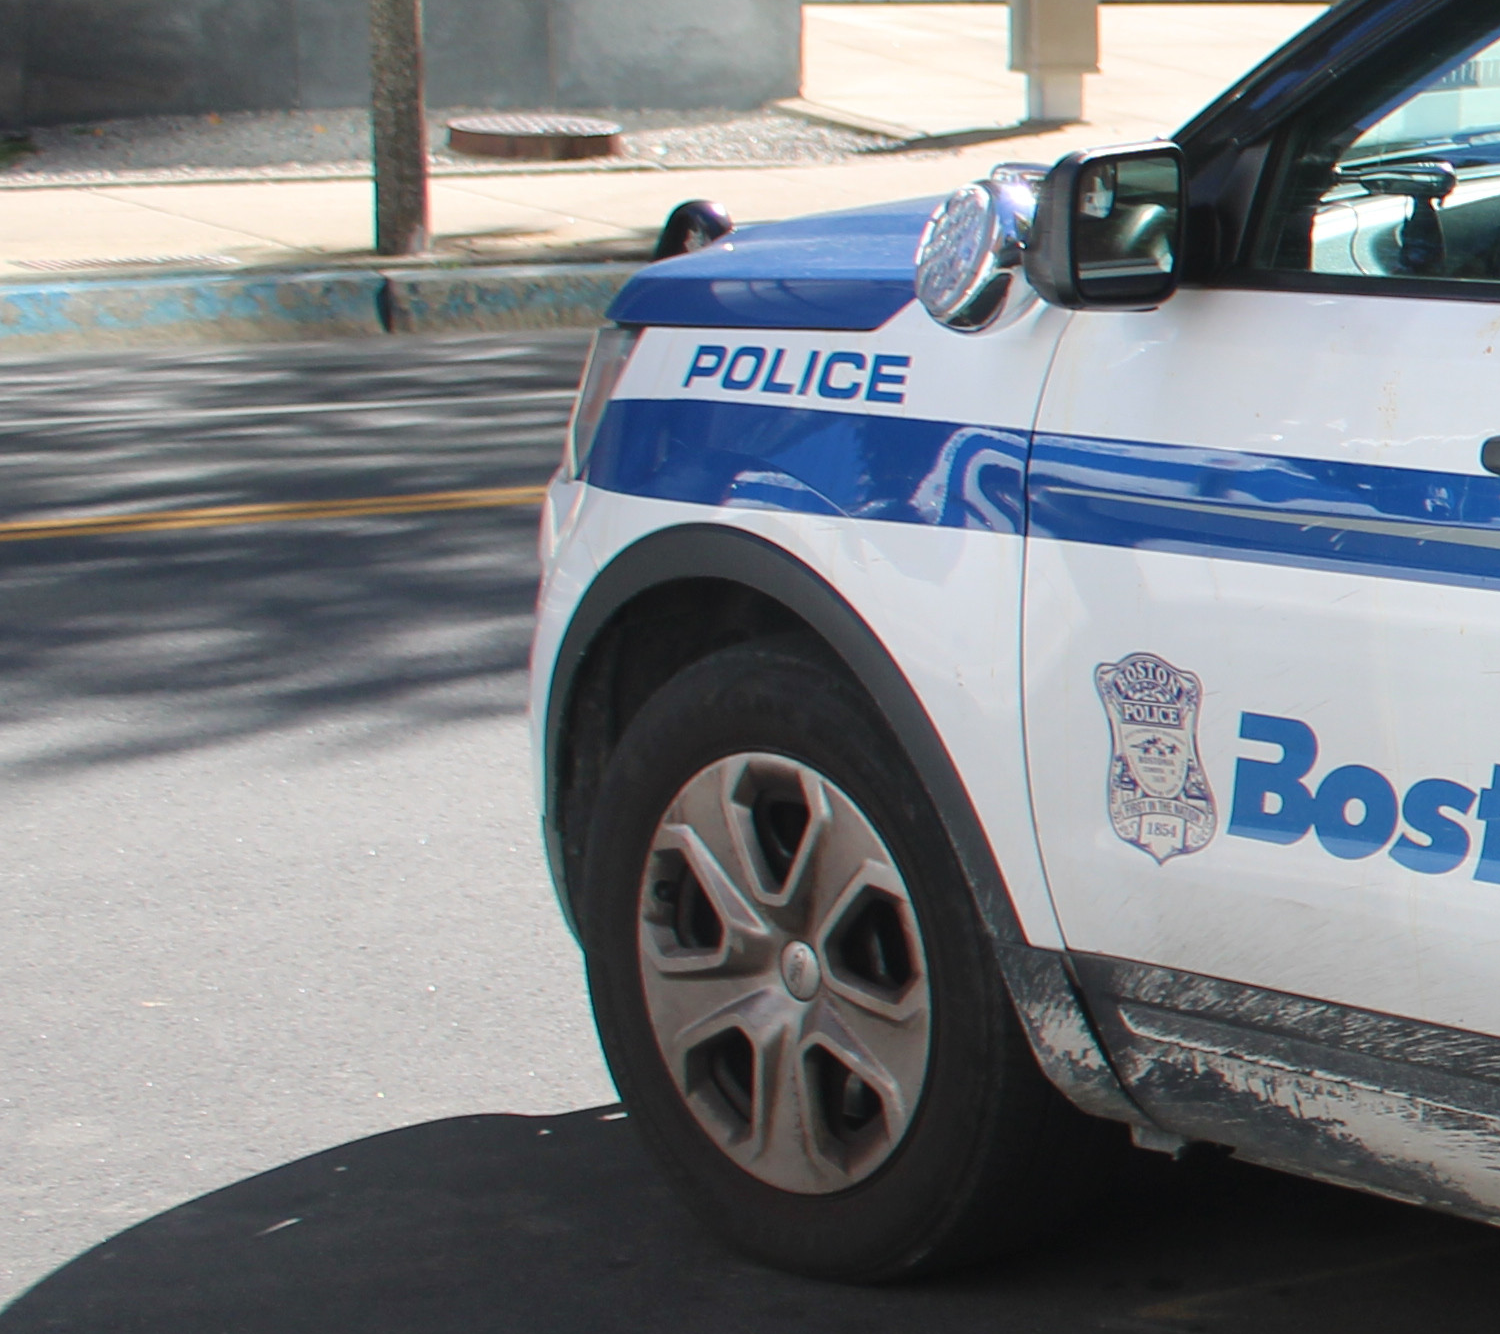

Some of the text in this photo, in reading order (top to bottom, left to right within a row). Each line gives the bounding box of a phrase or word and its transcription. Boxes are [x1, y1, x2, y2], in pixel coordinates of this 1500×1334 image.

[681, 344, 913, 405] POLICE
[1115, 661, 1182, 696] BOSTON
[1124, 703, 1180, 726] POLICE
[1124, 800, 1202, 823] FIRST IN THE NATION
[1146, 821, 1177, 838] 1854
